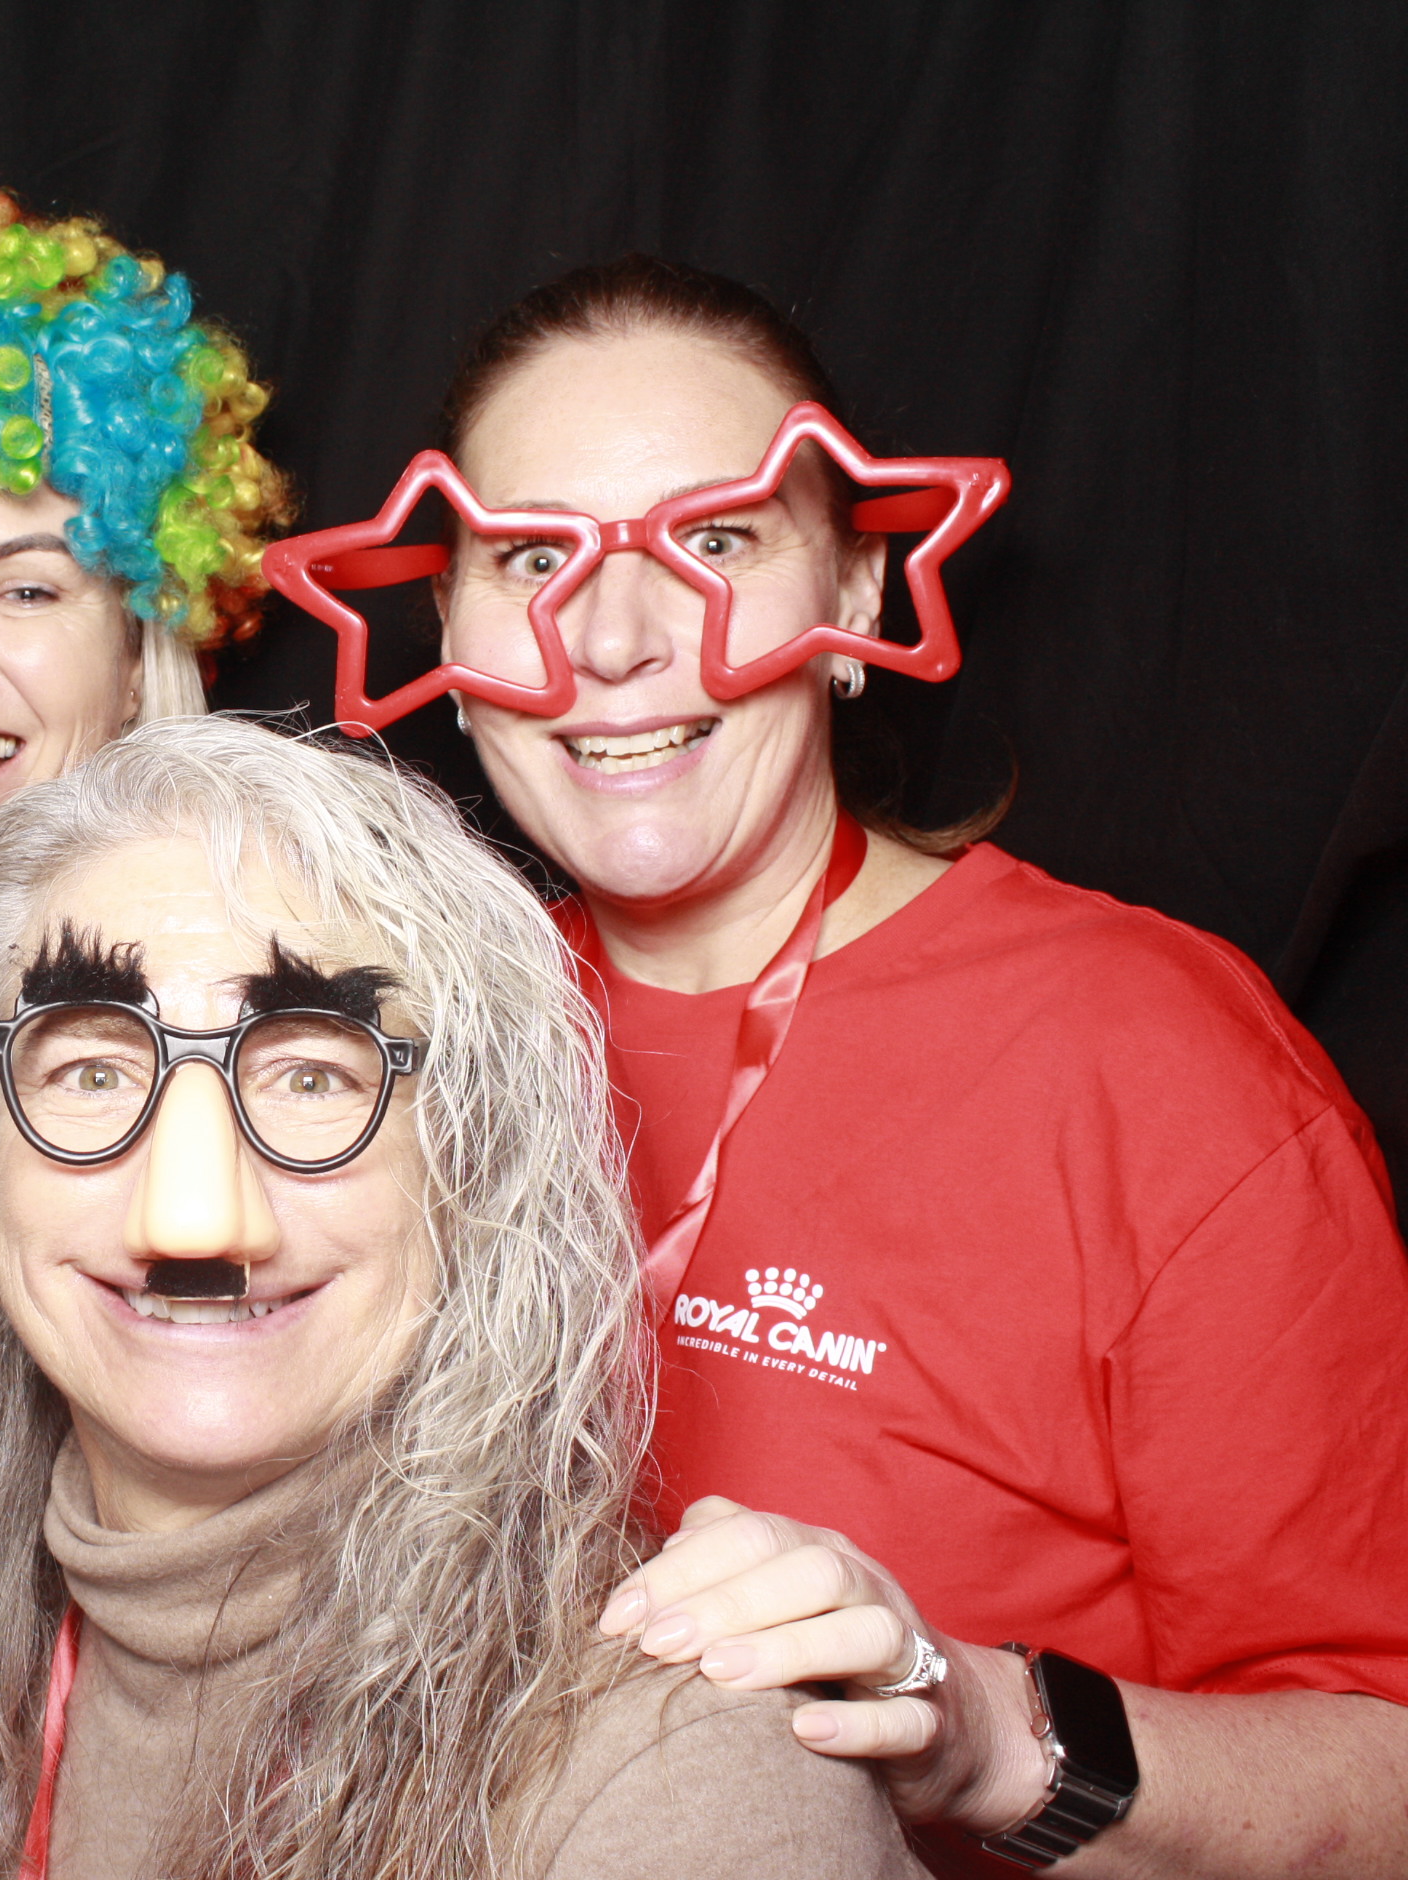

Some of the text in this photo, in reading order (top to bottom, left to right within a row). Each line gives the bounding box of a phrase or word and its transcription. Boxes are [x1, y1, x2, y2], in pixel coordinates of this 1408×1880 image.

[675, 1293, 760, 1344] ROYAL
[677, 1335, 858, 1391] INCREDIBLE IN EVERY DETAIL
